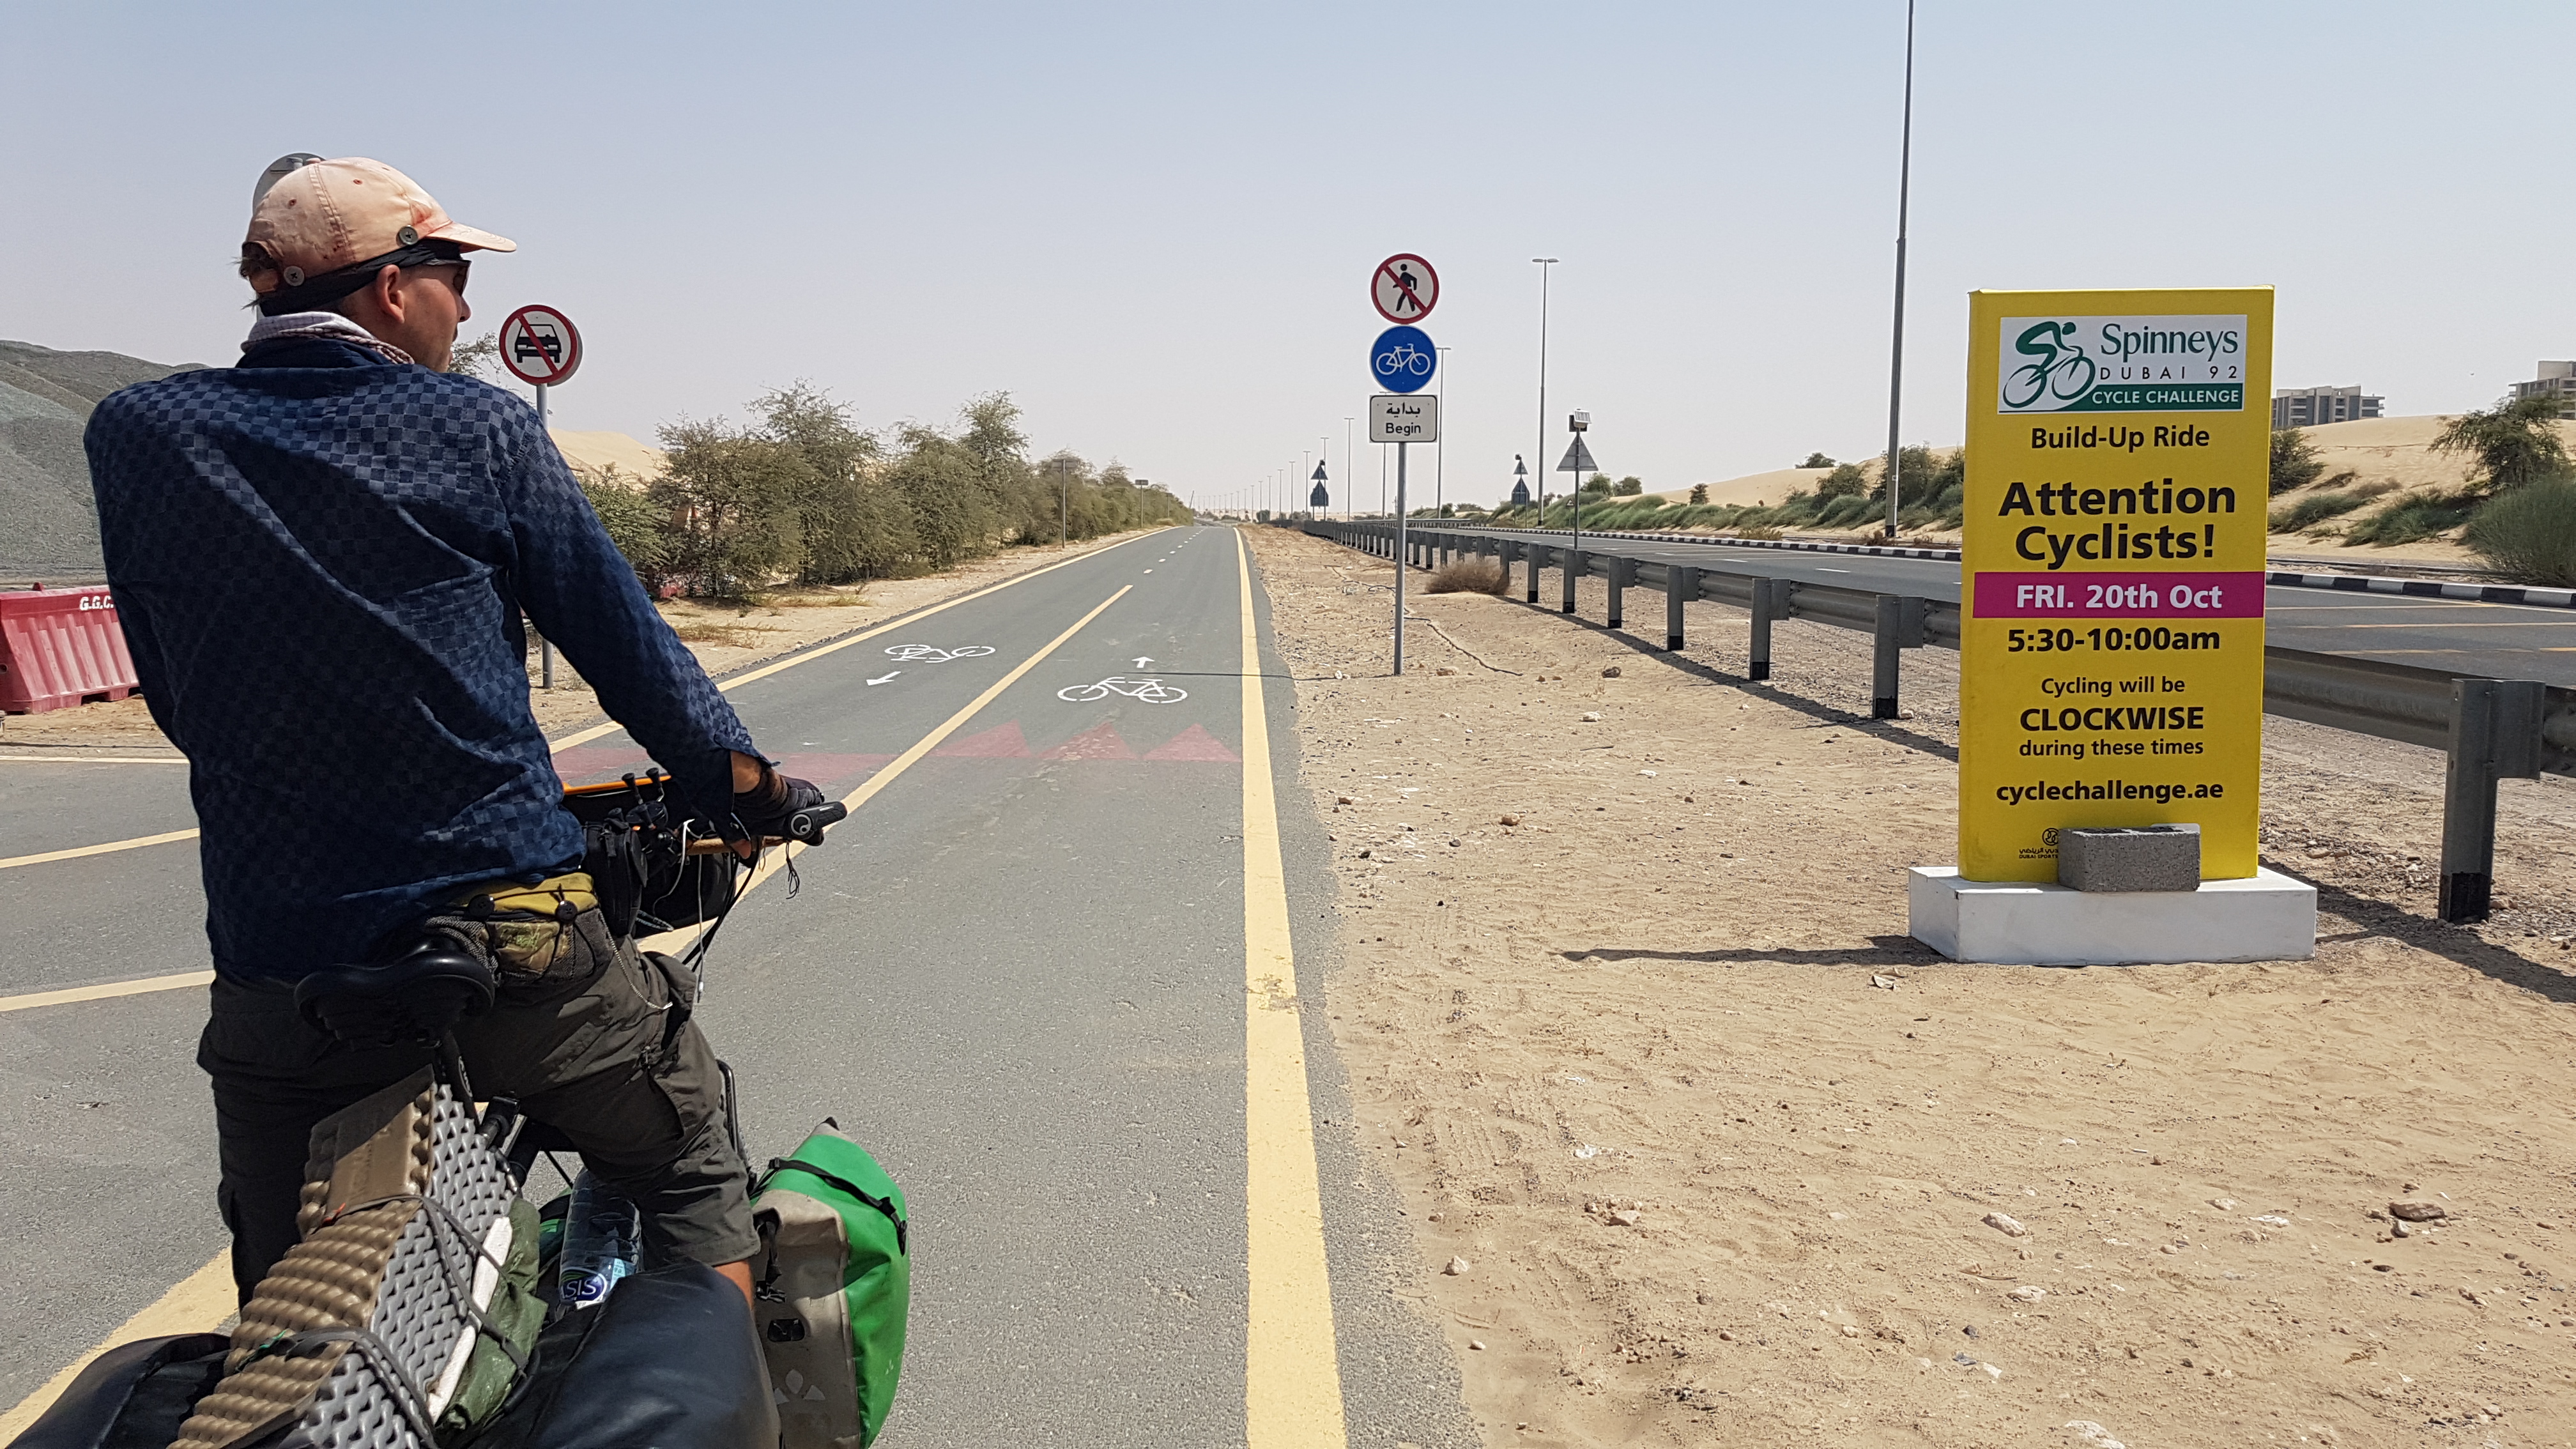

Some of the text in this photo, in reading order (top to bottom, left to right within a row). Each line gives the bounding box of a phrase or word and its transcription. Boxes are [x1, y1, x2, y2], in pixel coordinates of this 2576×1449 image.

[2100, 323, 2238, 363] Spinneys
[2100, 365, 2237, 380] DUBAI 92
[1386, 401, 1422, 418] بداية
[2092, 389, 2239, 404] CYCLE CHALLENGE
[1385, 422, 1422, 436] Begin
[2031, 424, 2211, 453] Build-Up Ride
[1998, 478, 2236, 516] Attention
[2015, 523, 2215, 571] Cyclists!
[2016, 583, 2223, 609] FRI. 20th Oct
[2007, 626, 2221, 652] 5:30-10:00am
[2041, 675, 2186, 698] Cycling will be
[2020, 706, 2205, 732] CLOCKWISE
[2019, 738, 2204, 760] during these times
[1996, 779, 2224, 806] cyclechallenge.ae
